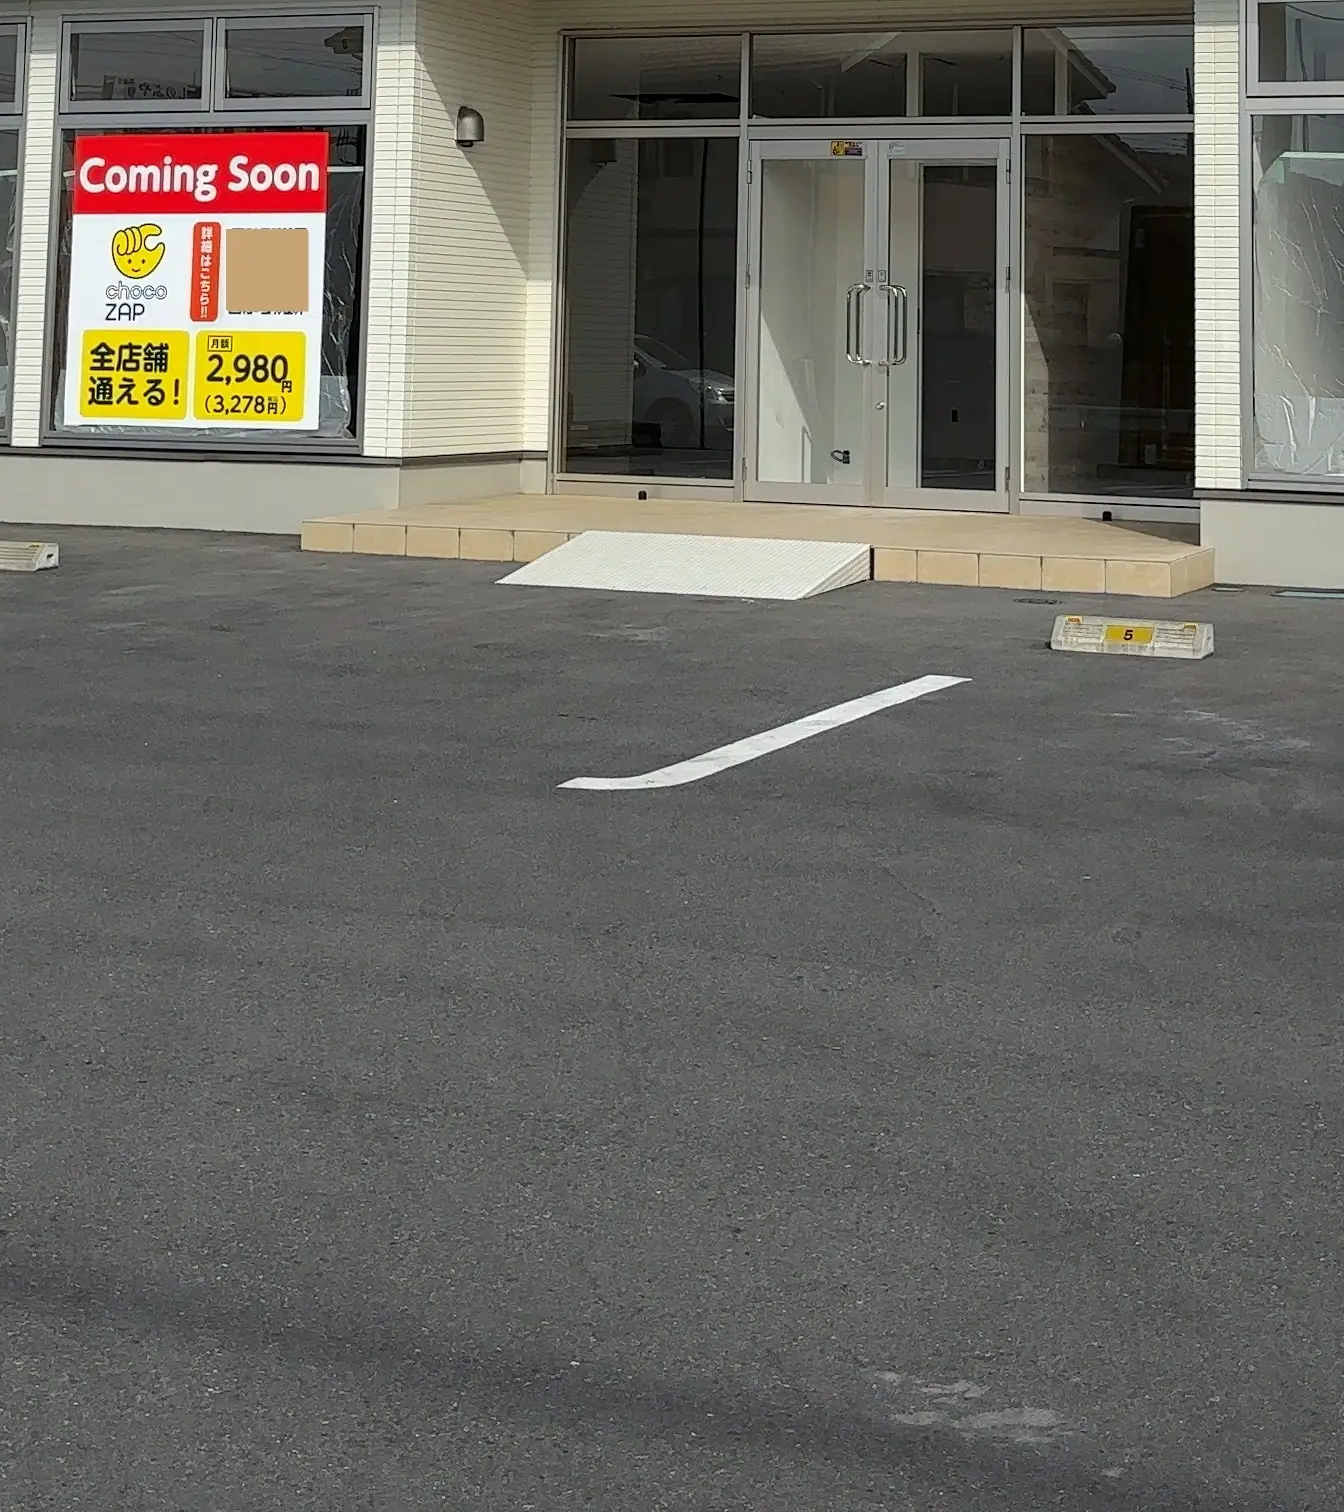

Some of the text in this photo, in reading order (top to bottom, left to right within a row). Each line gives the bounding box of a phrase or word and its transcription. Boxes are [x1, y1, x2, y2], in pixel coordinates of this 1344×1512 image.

[79, 154, 320, 203] Coming Soon
[105, 280, 168, 300] choco
[105, 302, 146, 322] ZAP
[210, 338, 230, 349] 月額
[89, 341, 170, 374] 全店舗
[1123, 629, 1134, 641] 5
